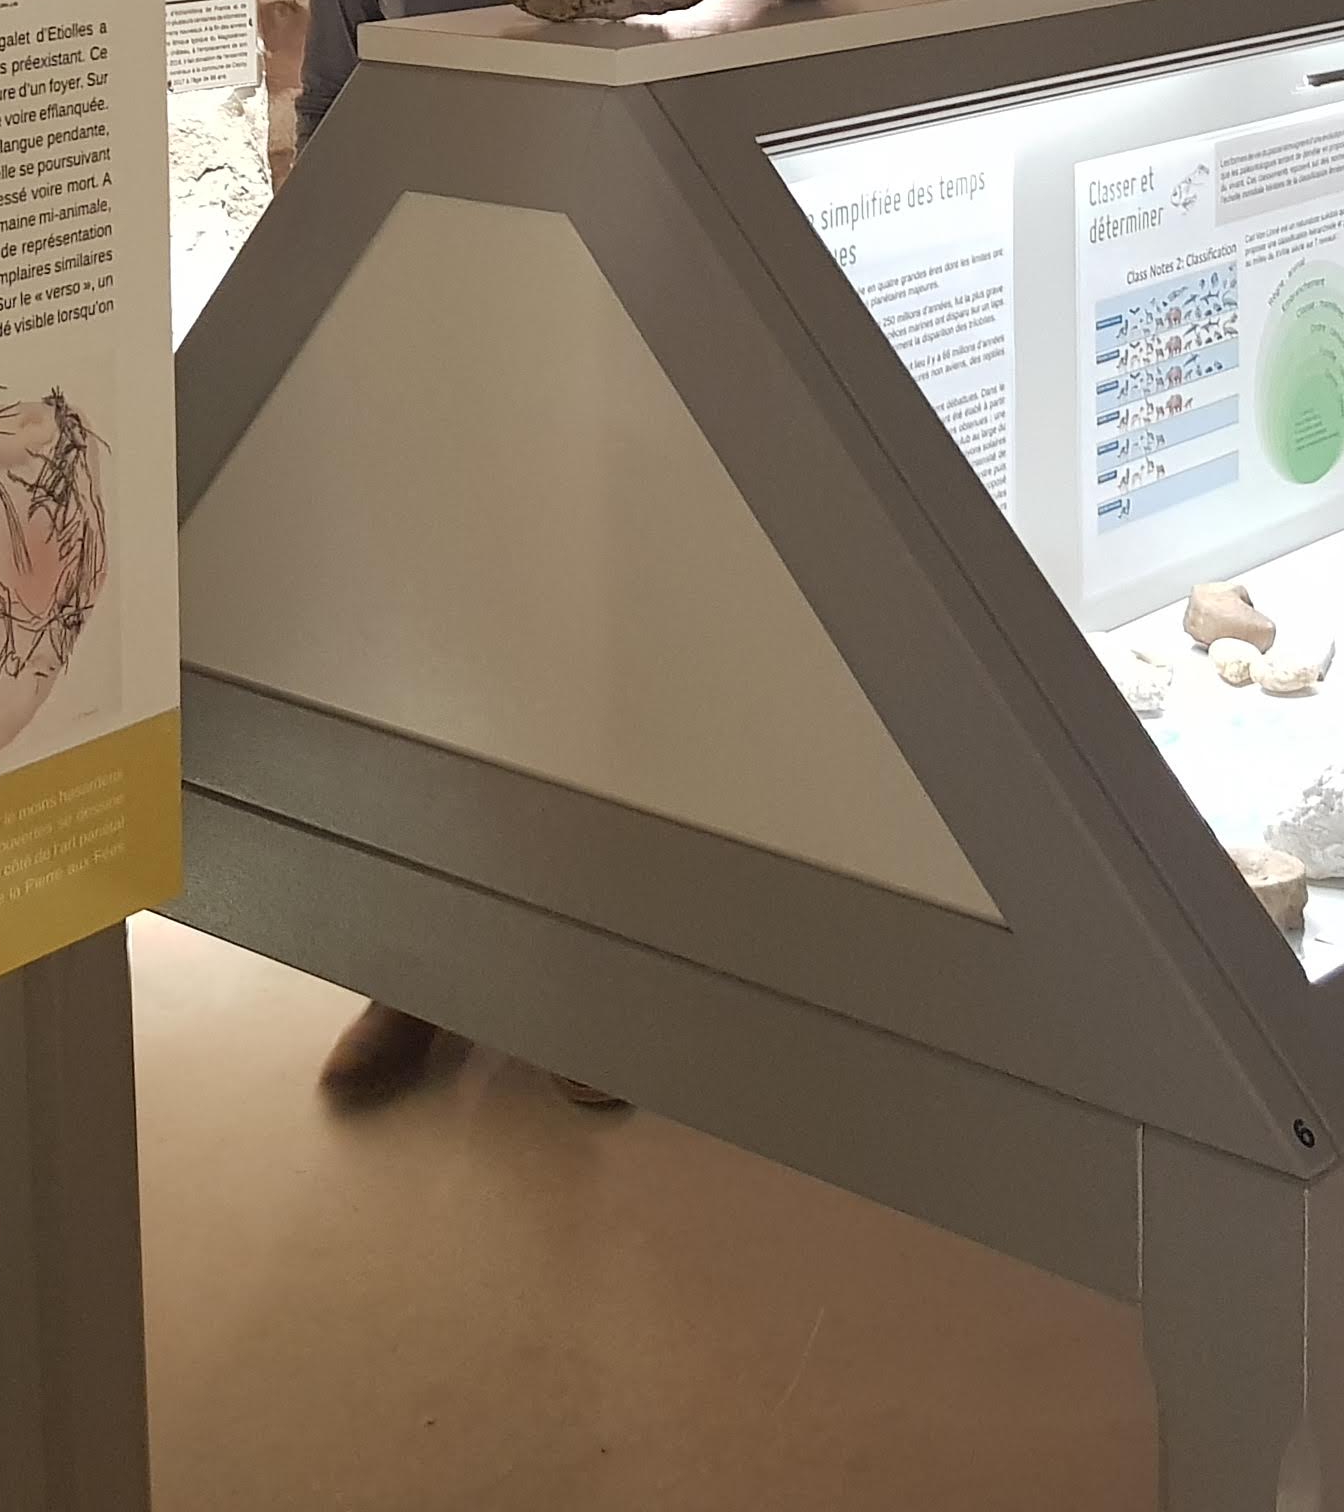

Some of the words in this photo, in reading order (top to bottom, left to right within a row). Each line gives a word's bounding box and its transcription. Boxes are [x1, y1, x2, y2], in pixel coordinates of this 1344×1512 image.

[821, 189, 901, 231] simplifiée
[908, 180, 933, 208] des
[939, 172, 985, 200] temps
[1089, 173, 1136, 207] Classer
[1141, 165, 1155, 192] et
[1089, 205, 1164, 245] déterminer
[1126, 265, 1148, 285] Class
[1150, 258, 1173, 278] Notes
[1186, 242, 1237, 269] Classification
[1294, 1119, 1315, 1148] 6
